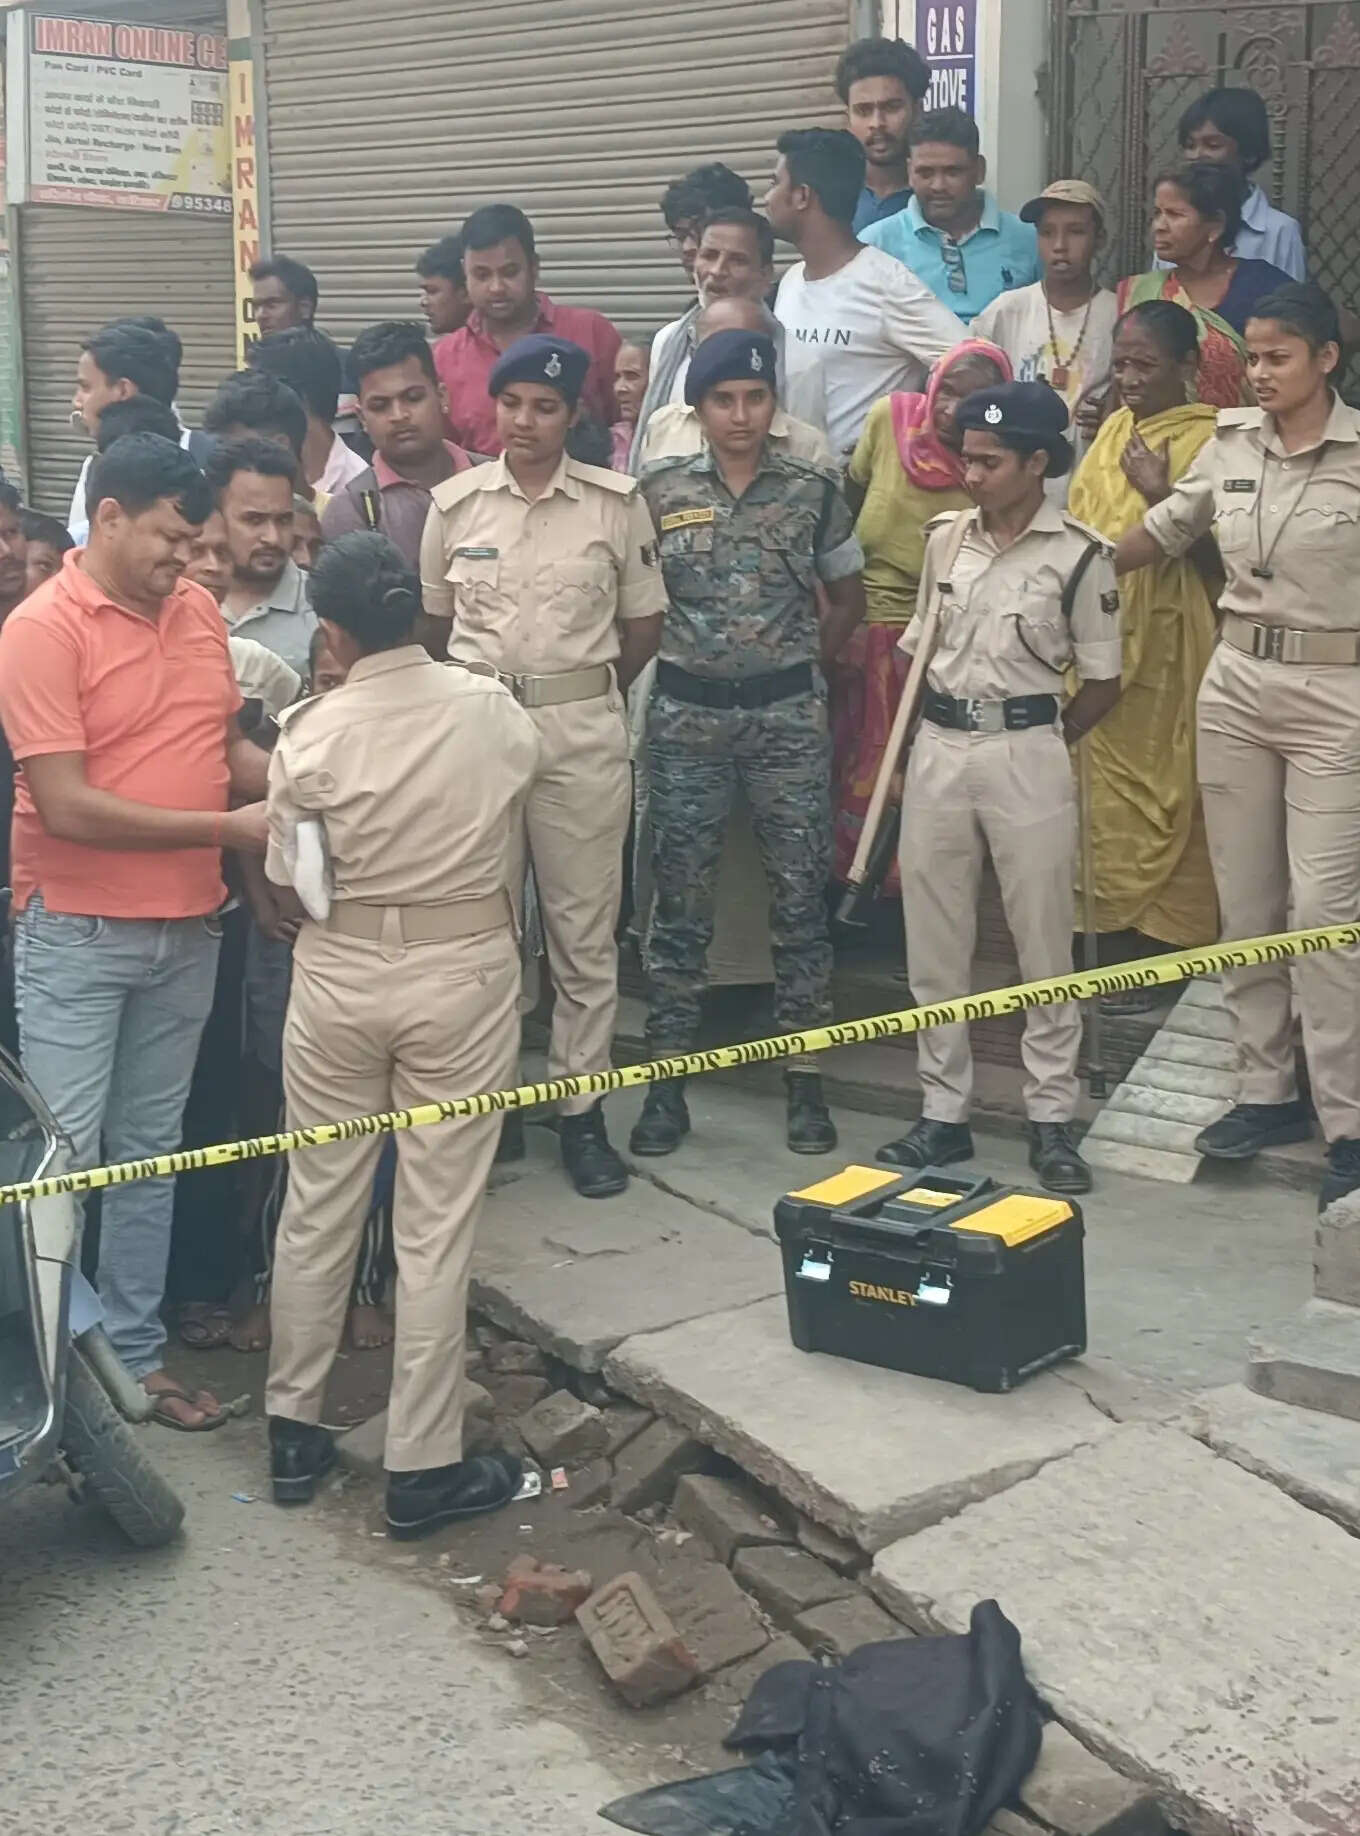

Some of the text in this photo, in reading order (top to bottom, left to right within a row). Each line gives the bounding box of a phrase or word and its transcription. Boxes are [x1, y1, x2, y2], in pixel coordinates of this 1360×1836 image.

[35, 16, 113, 57] IMRAN
[114, 25, 194, 66] ONLINE
[927, 6, 965, 54] GAS
[923, 68, 967, 112] STOVE
[235, 73, 260, 273] IMRAN
[848, 1280, 918, 1307] STANLEY
